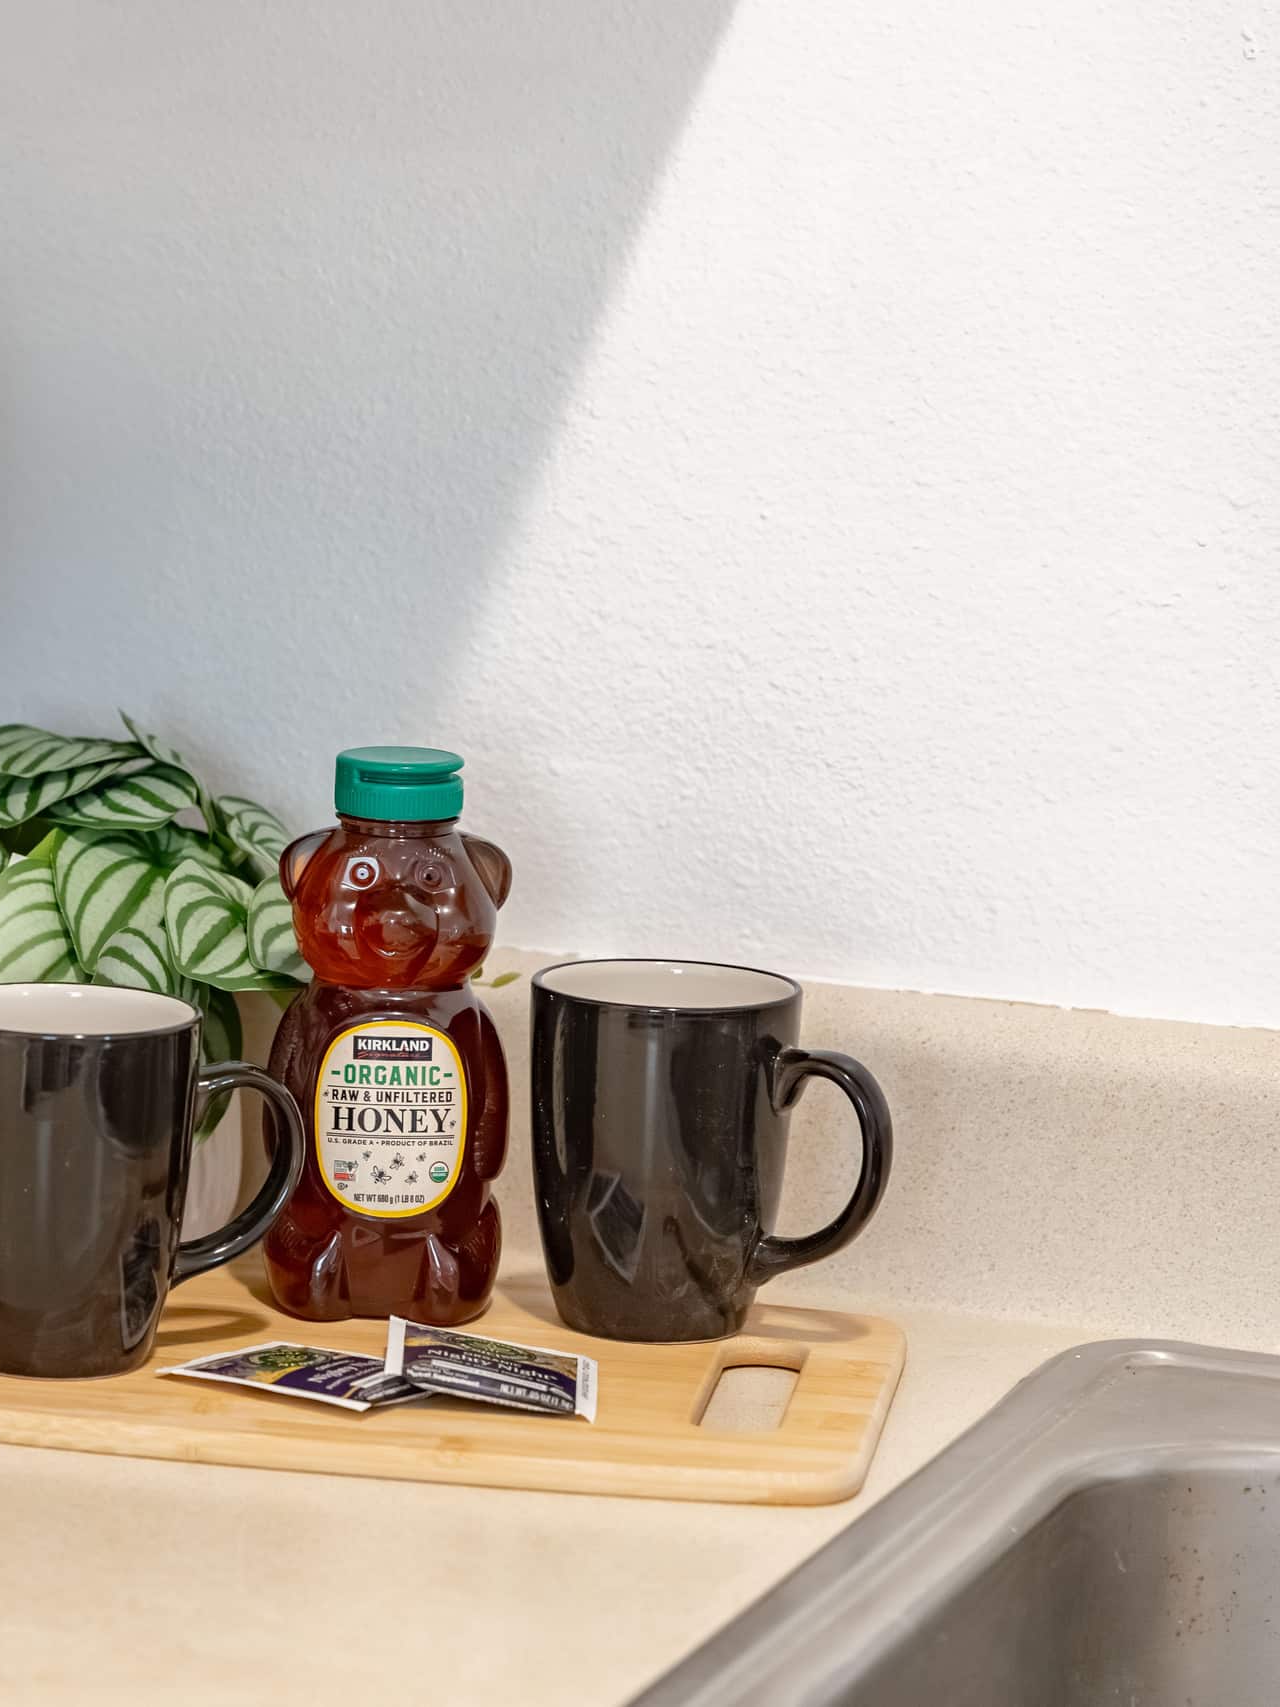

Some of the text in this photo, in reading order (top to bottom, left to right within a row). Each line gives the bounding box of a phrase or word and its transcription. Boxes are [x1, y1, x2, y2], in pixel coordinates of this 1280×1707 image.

[357, 1038, 430, 1052] KIRKLAND
[343, 1063, 441, 1087] ORGANIC
[331, 1089, 453, 1104] RAW & UNFILTERED
[330, 1106, 452, 1134] HONEY
[342, 1137, 367, 1146] GRADE
[380, 1139, 416, 1147] PRODUCT
[417, 1139, 427, 1147] OF
[429, 1138, 454, 1147] BRAZIL
[353, 1193, 365, 1202] NET
[366, 1193, 376, 1203] WT
